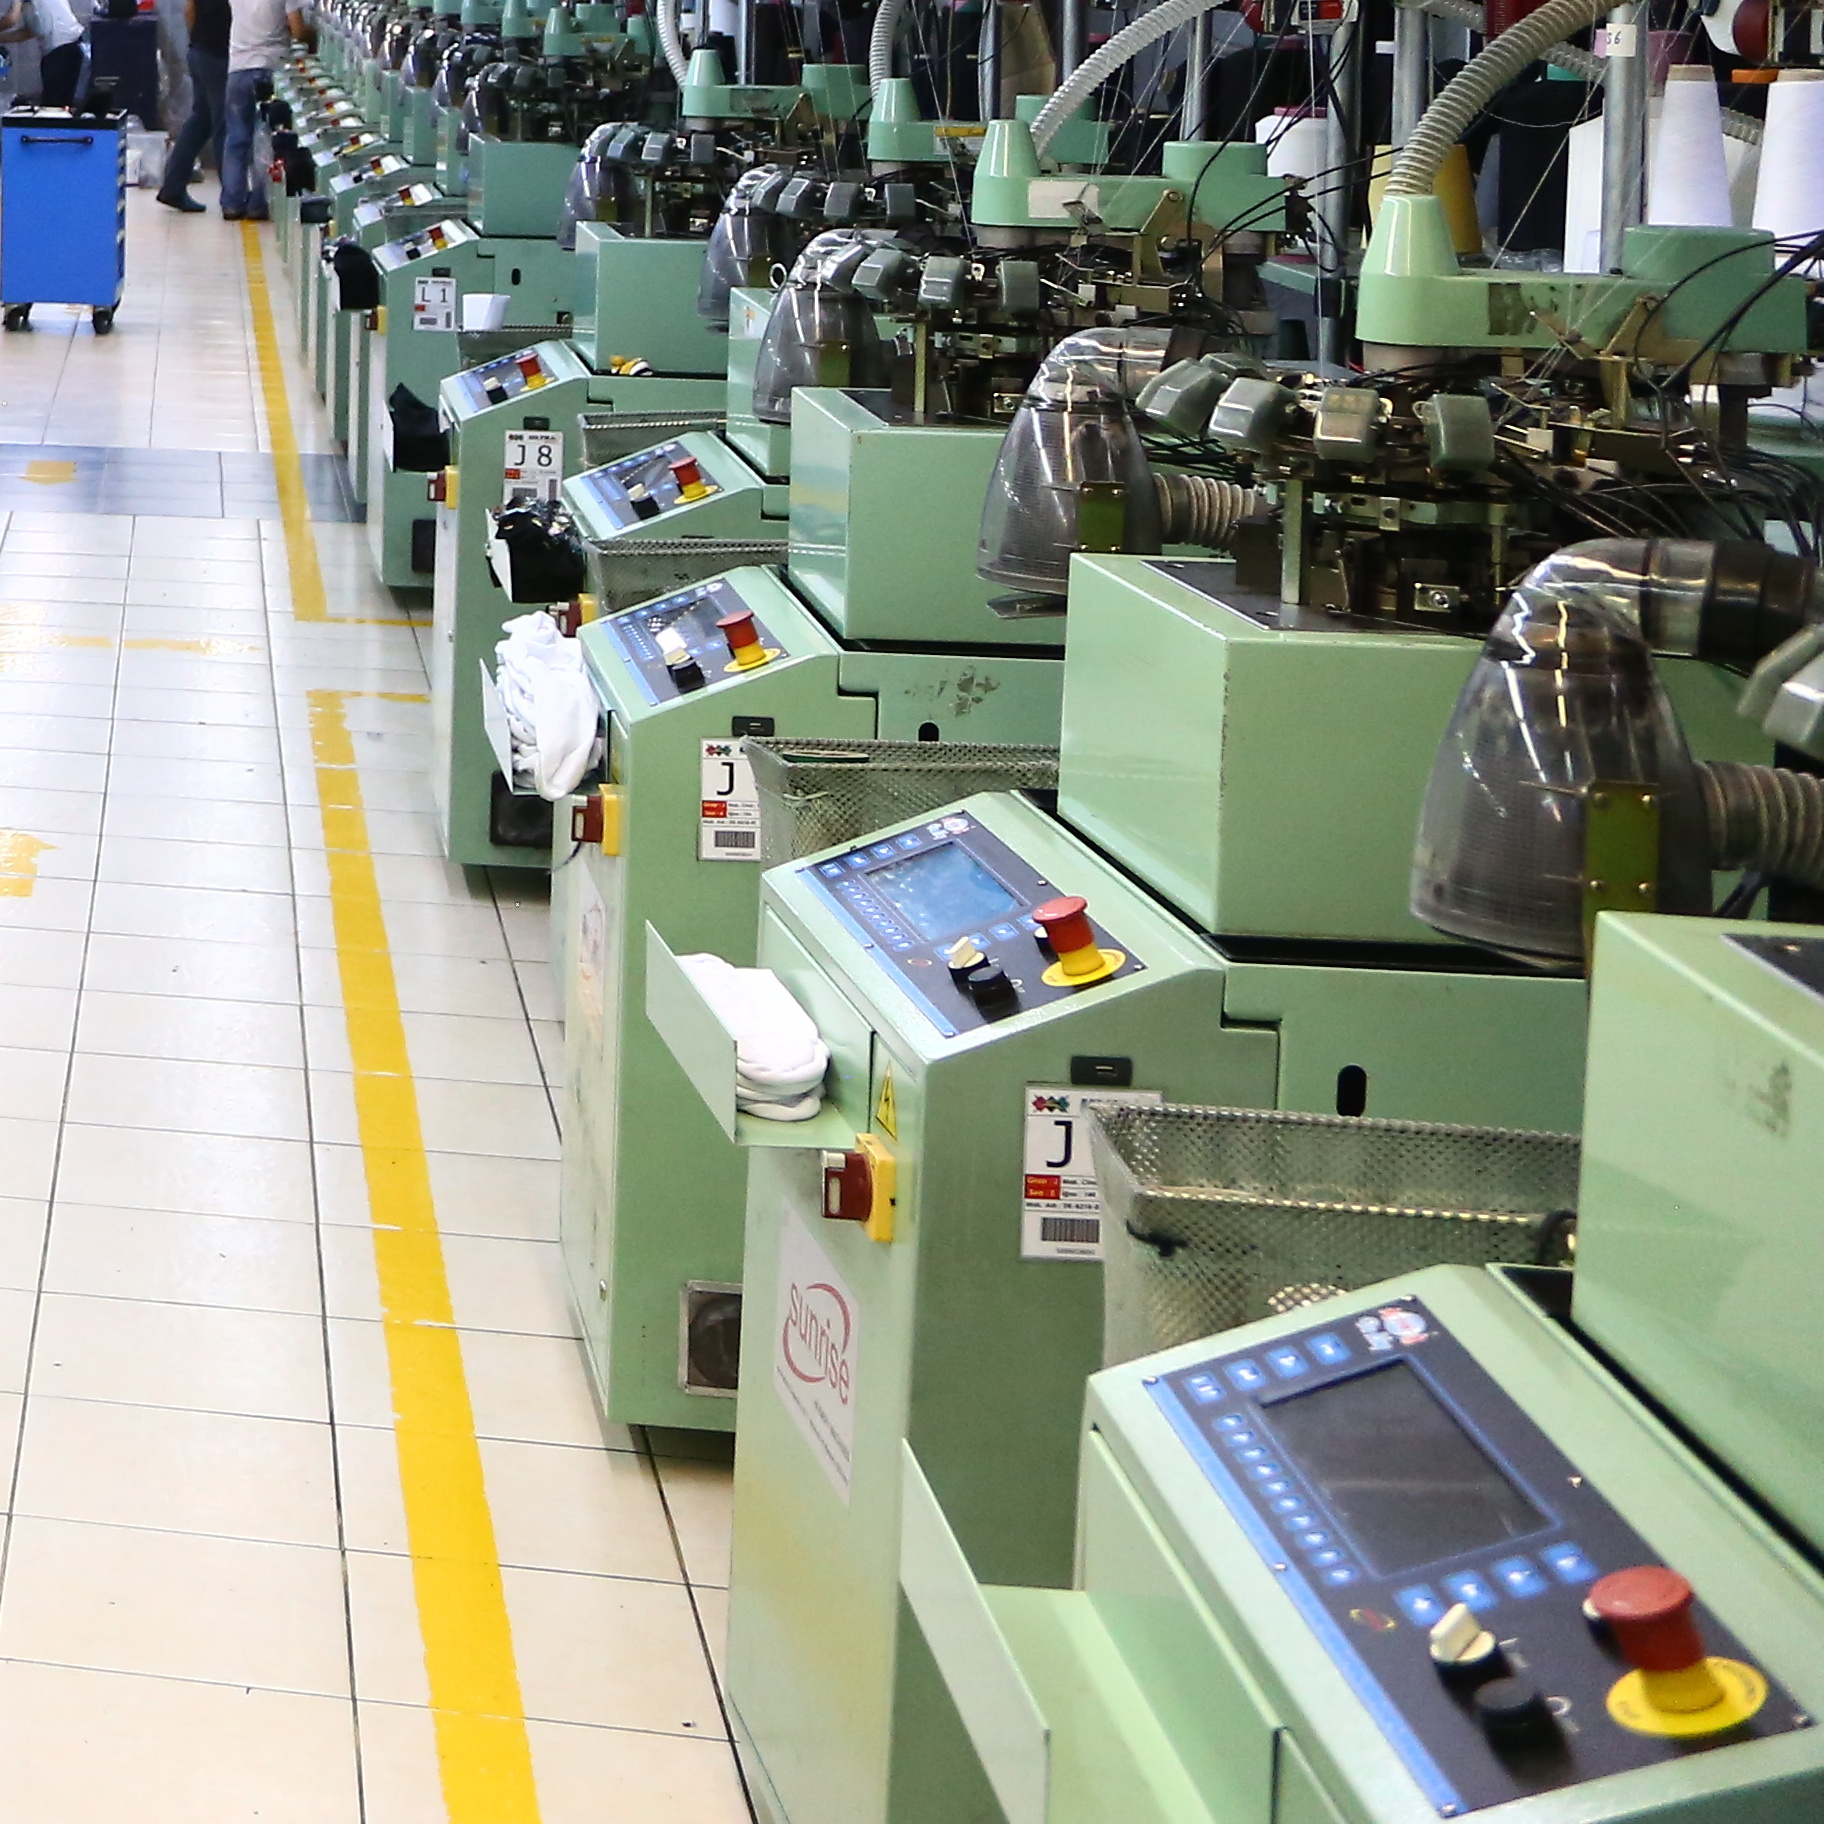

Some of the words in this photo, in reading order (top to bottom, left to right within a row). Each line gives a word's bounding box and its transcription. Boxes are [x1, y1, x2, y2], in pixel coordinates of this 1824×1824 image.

[422, 286, 432, 303] L
[440, 287, 448, 303] 1
[514, 444, 526, 466] J
[537, 444, 553, 467] 8
[716, 761, 735, 796] J
[1046, 1119, 1074, 1168] J
[789, 1282, 850, 1406] sunrise
